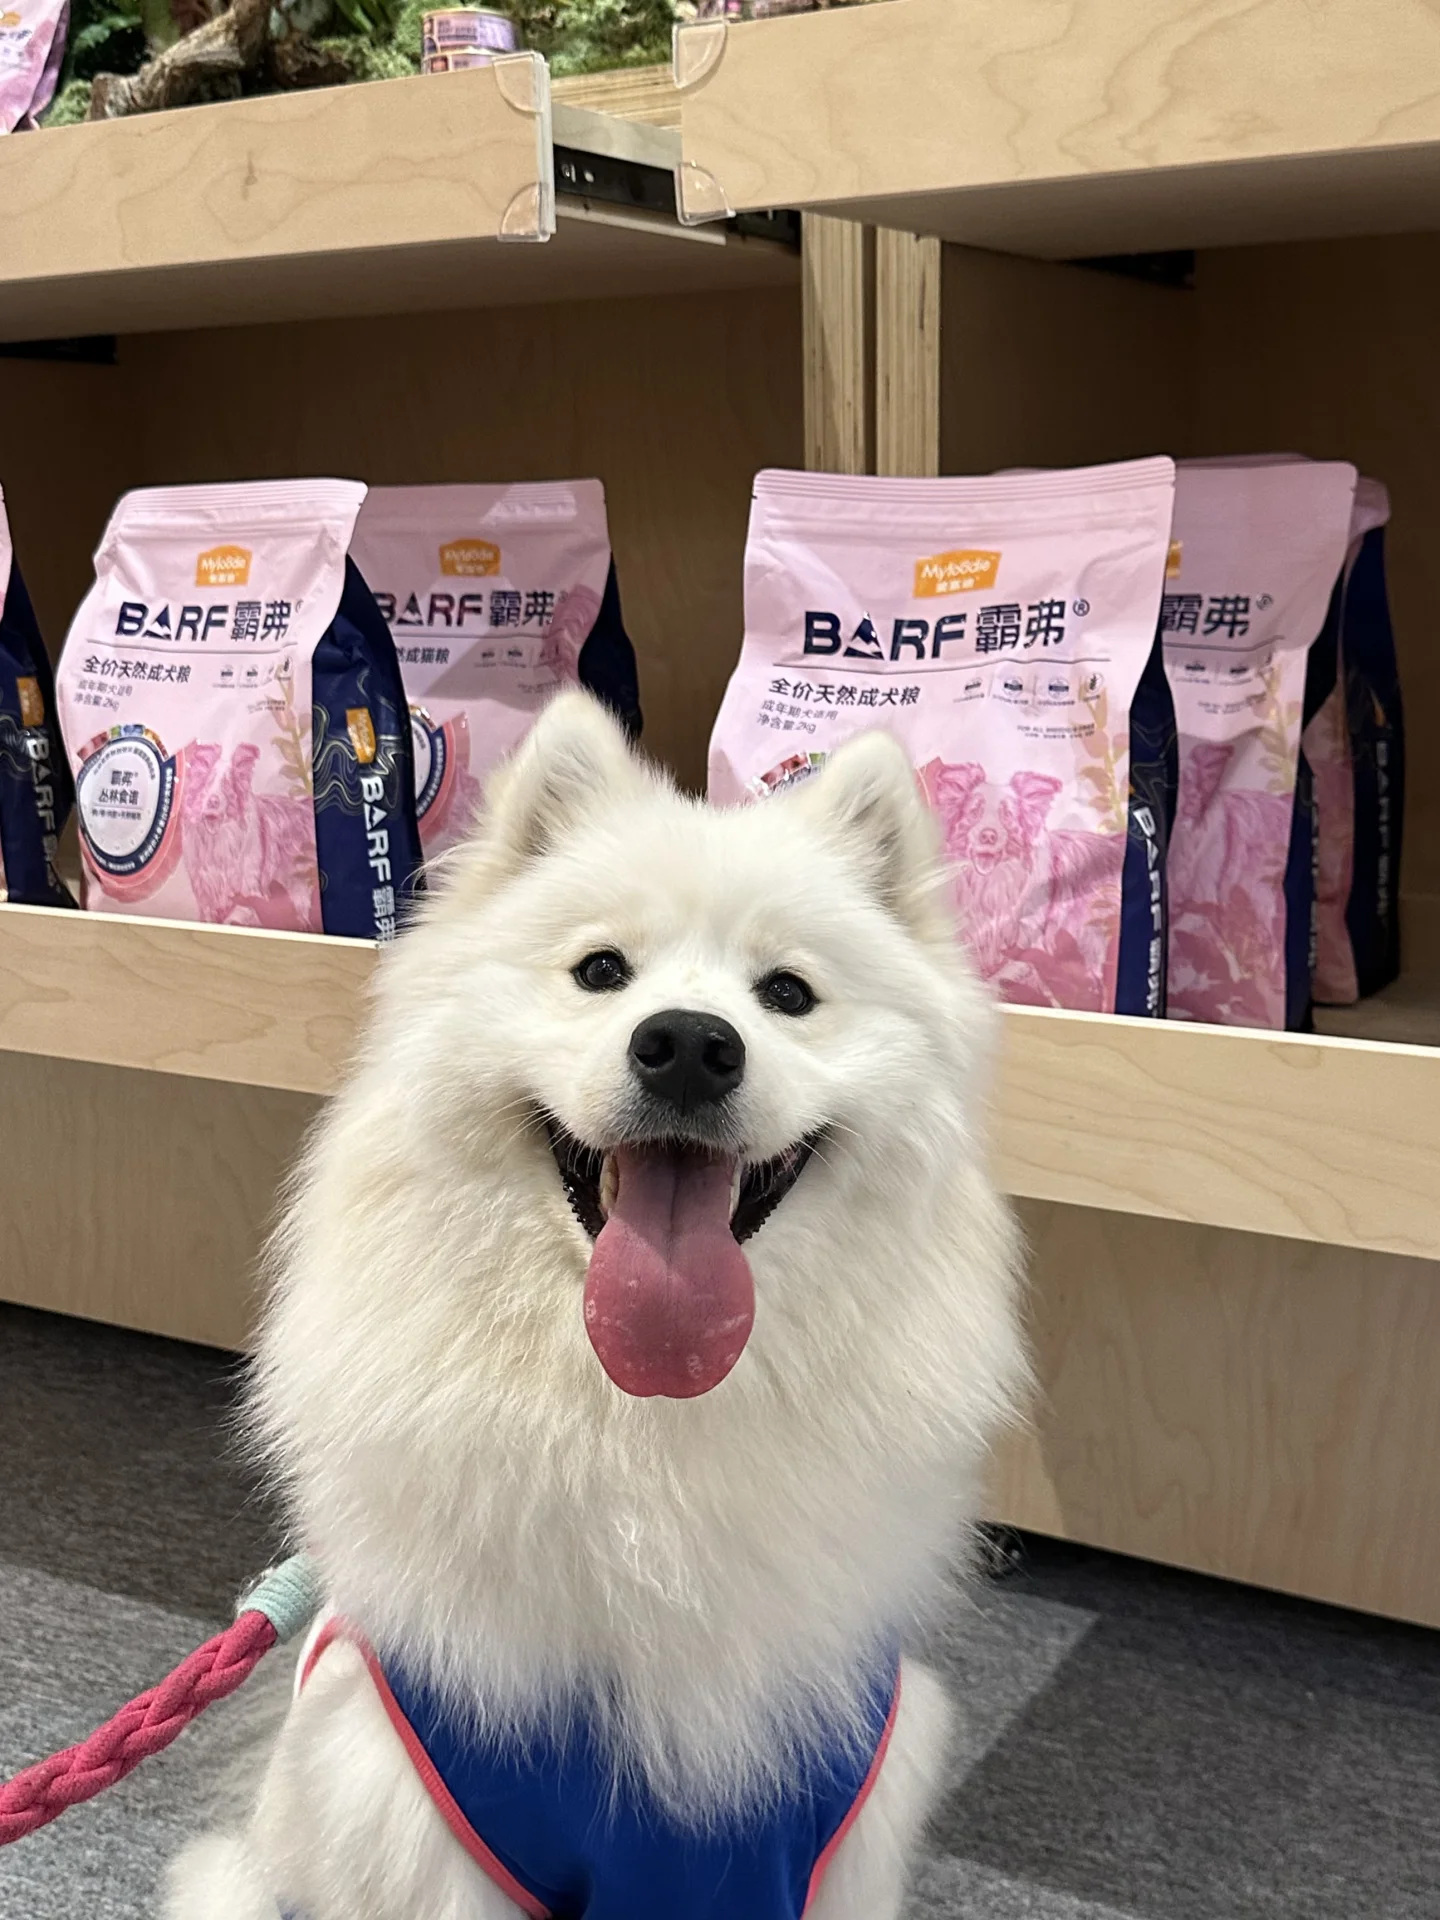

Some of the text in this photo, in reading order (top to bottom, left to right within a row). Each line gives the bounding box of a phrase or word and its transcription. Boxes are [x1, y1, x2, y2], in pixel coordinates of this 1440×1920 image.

[115, 599, 293, 642] BARF 霸弗
[489, 590, 554, 628] 霸弗
[802, 597, 1067, 661] BARF 霸弗
[82, 655, 192, 684] 全价天然成犬粮
[768, 676, 922, 706] 全价天然成犬粮
[27, 737, 55, 837] BARF
[360, 776, 391, 890] BARF
